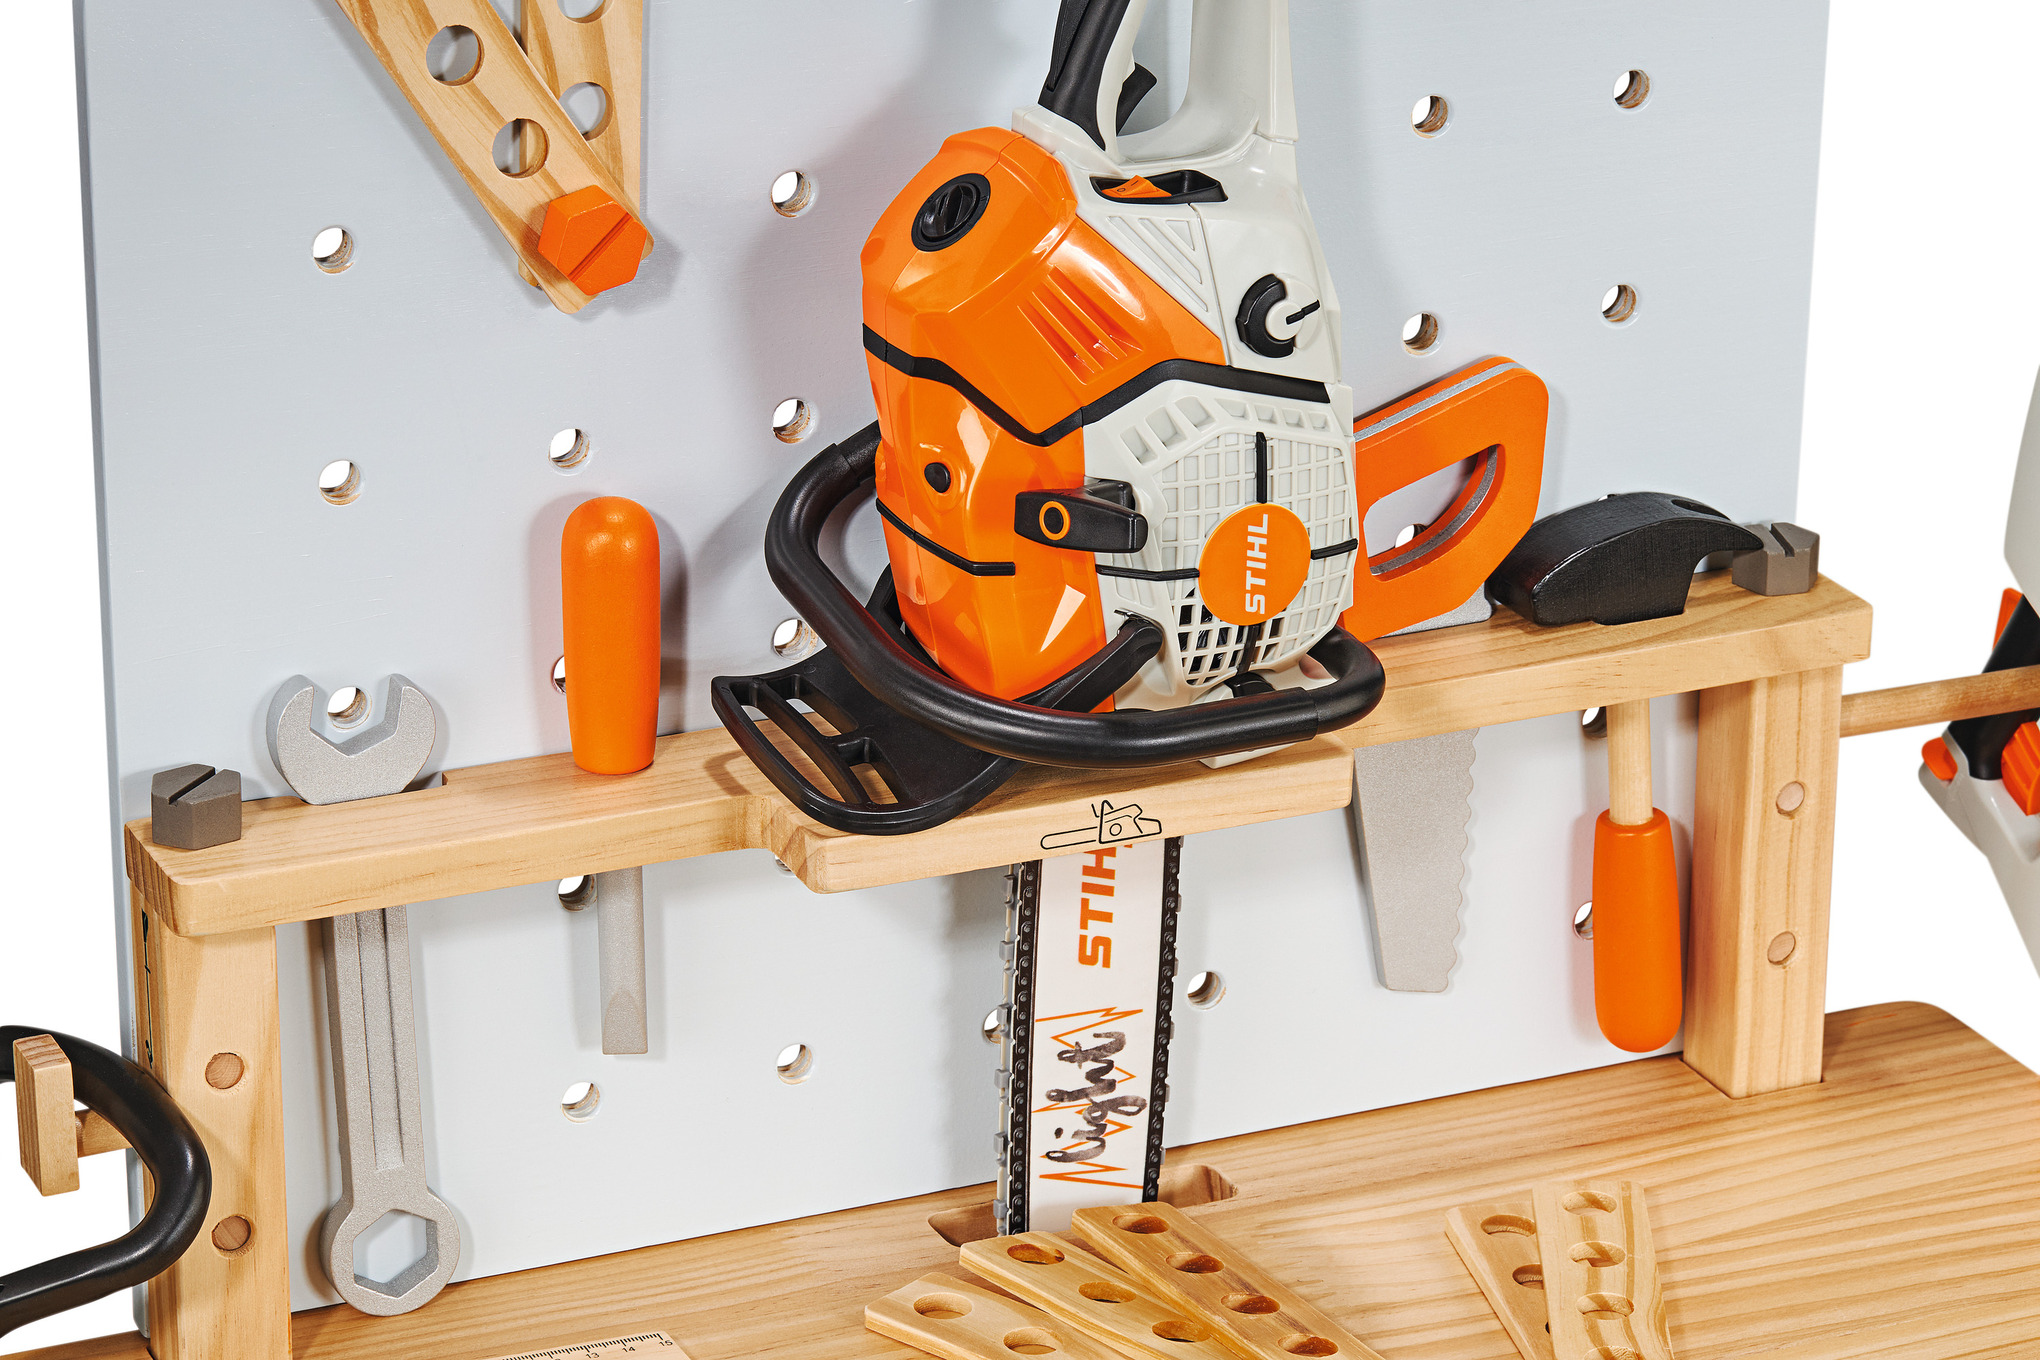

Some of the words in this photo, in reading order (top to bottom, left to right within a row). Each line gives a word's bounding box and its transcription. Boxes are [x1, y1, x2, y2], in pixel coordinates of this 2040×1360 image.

[1245, 513, 1269, 615] STIHL
[1078, 846, 1117, 969] STIH
[1045, 1031, 1148, 1163] light
[659, 1339, 673, 1347] 15
